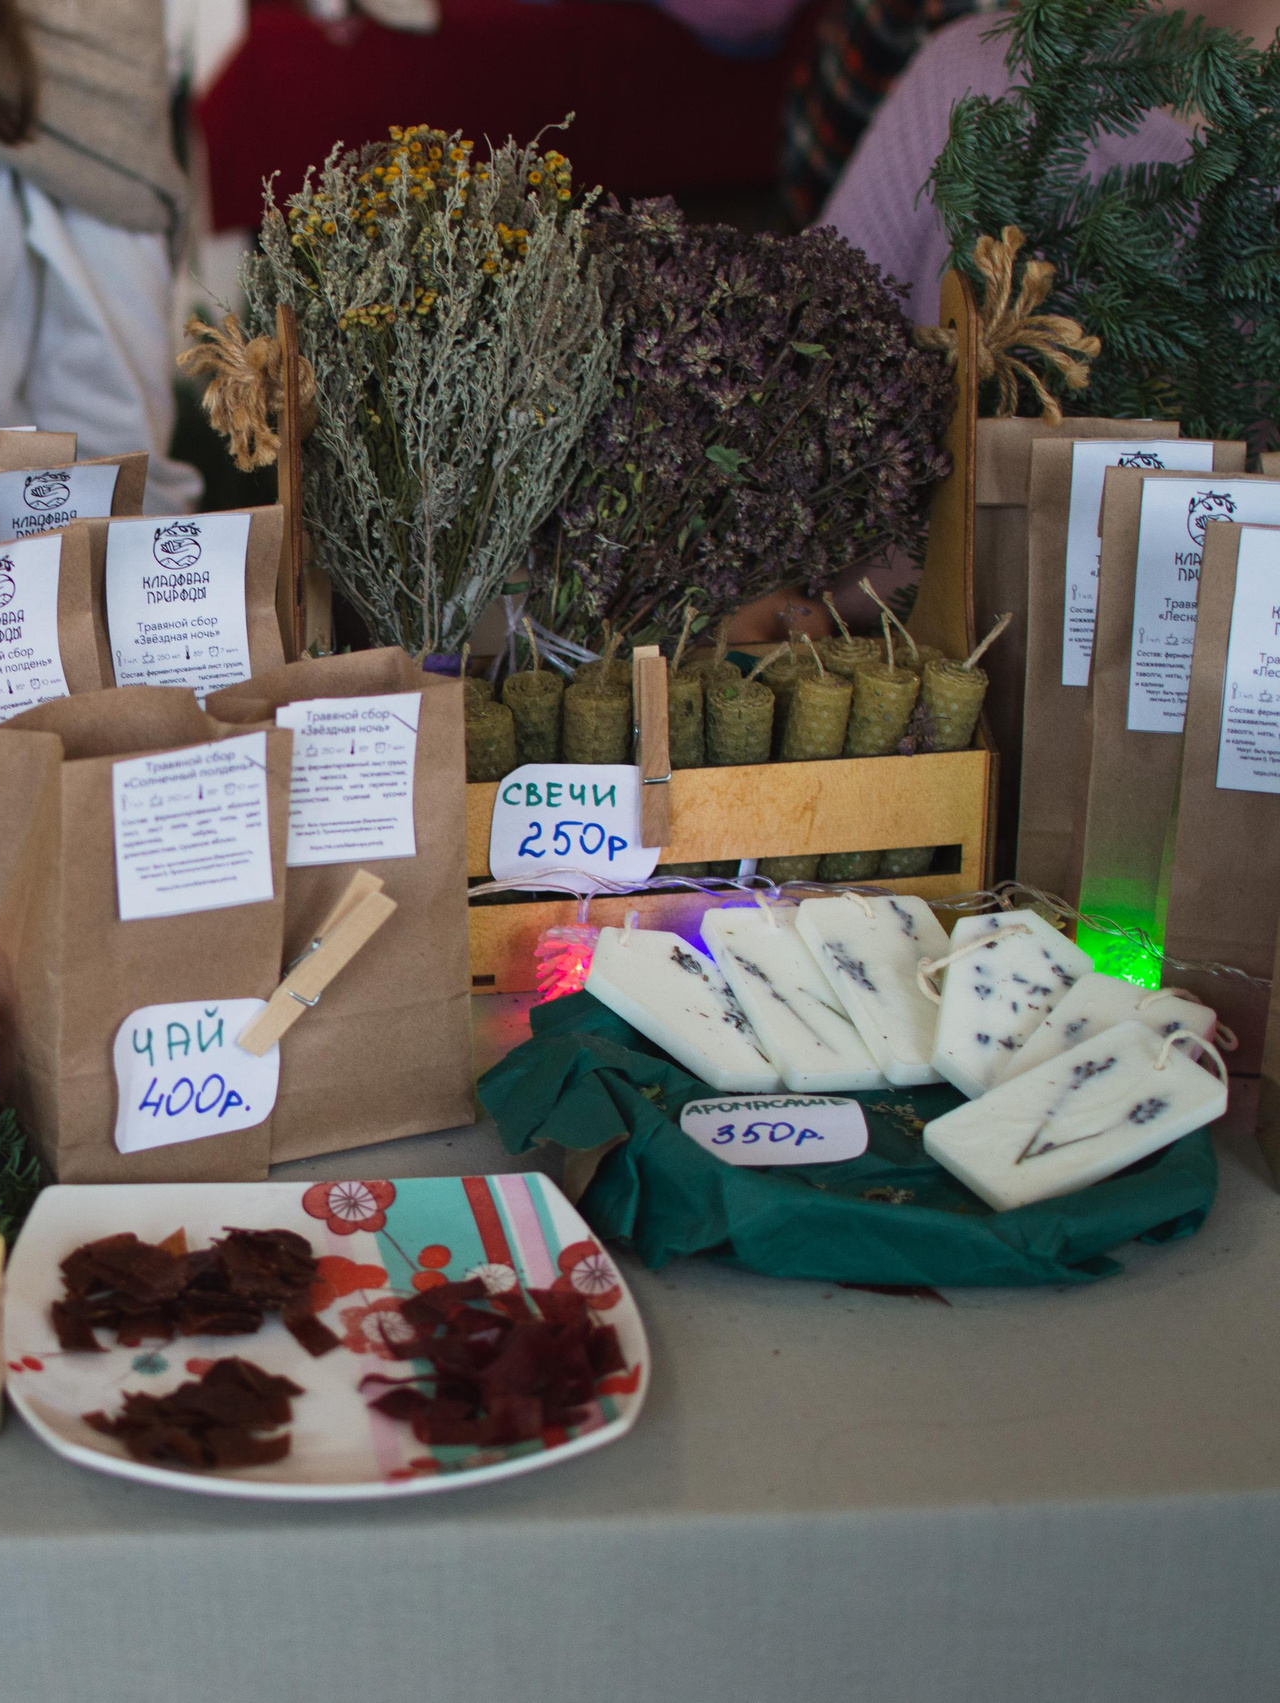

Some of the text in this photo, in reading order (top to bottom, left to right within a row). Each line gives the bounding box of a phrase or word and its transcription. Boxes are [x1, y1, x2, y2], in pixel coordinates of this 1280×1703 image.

[142, 571, 210, 589] КЛАДОВАЯ
[147, 586, 207, 604] ПРИРОДЫ
[136, 616, 218, 635] Травяной сбор
[134, 630, 221, 645] «Звёздная ночь»
[7, 647, 34, 660] сбор
[5, 658, 53, 674] полдень»
[306, 708, 391, 725] Травяной сбор
[502, 781, 616, 807] СВЕЧИ
[518, 820, 628, 861] 250р
[133, 1006, 224, 1066] ЧАЙ
[138, 1073, 251, 1118] 400р.
[711, 1122, 825, 1147] 350р.
